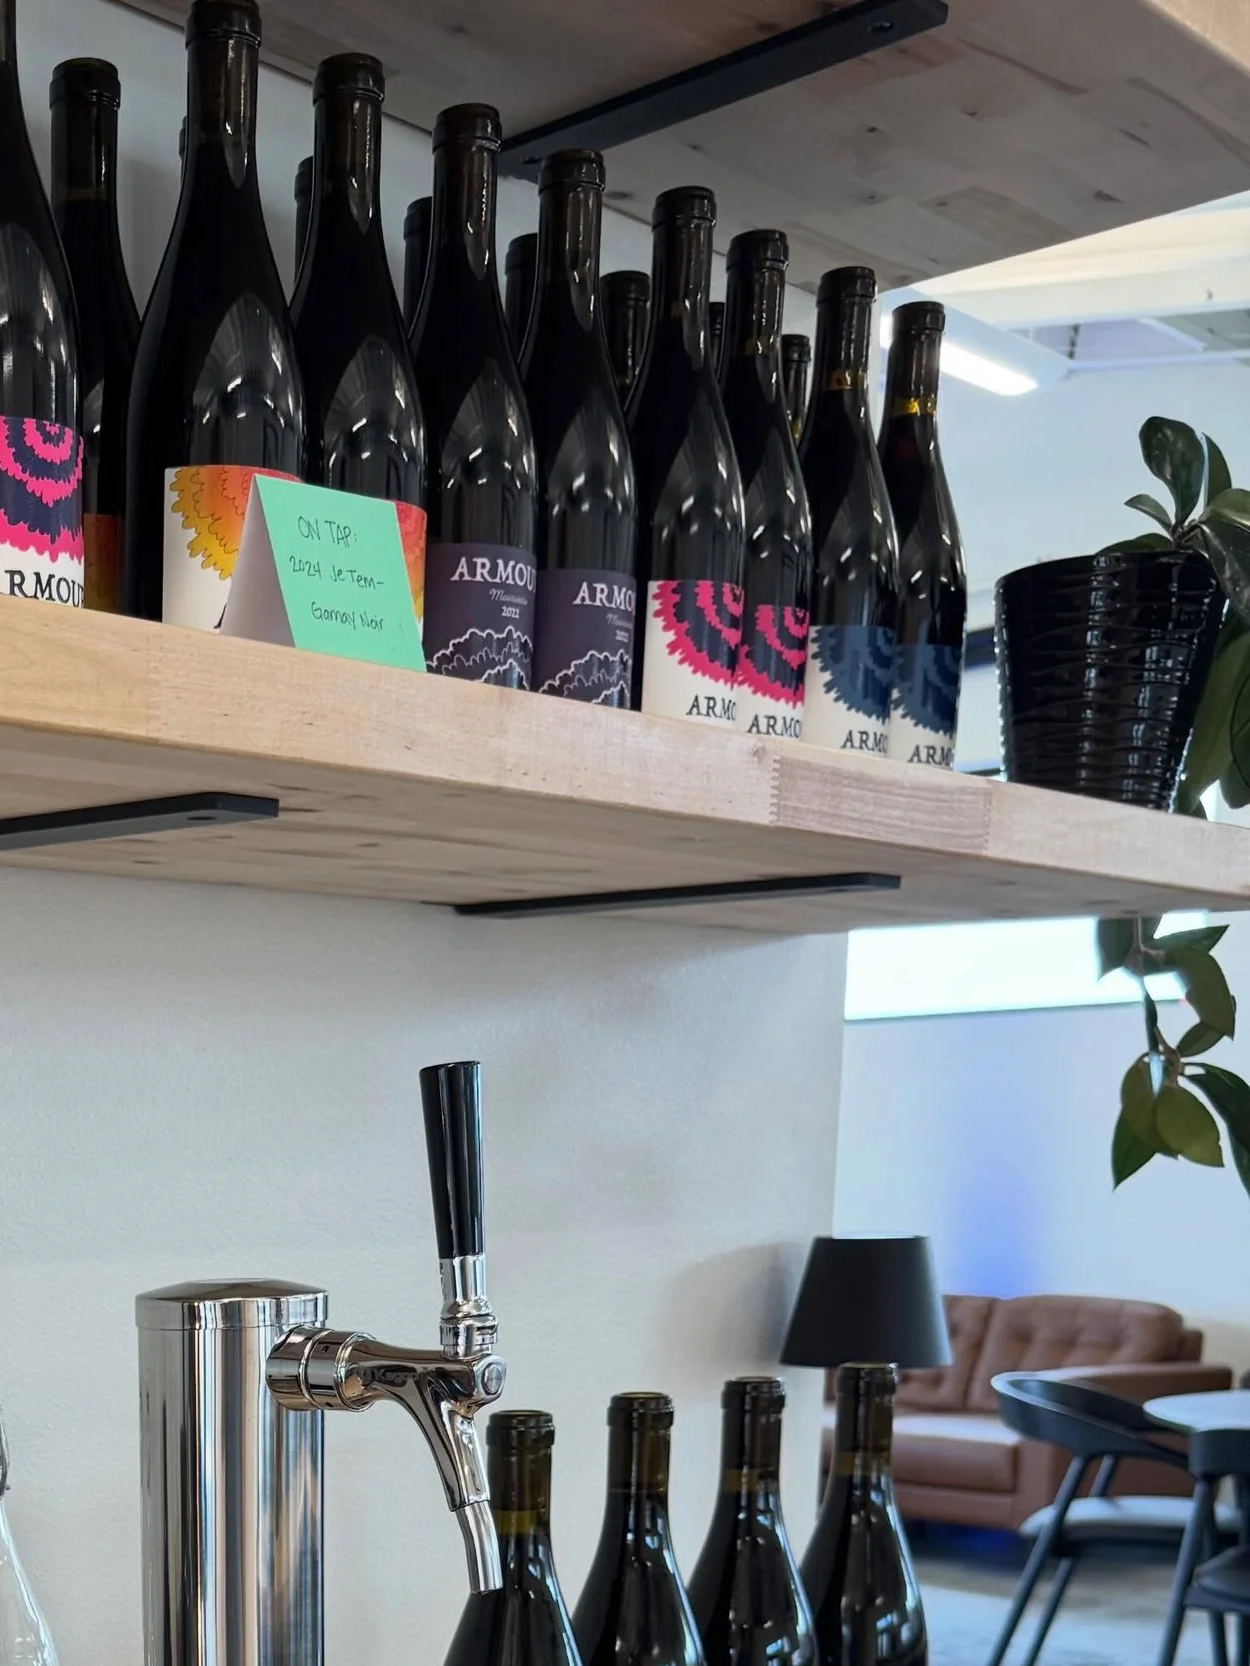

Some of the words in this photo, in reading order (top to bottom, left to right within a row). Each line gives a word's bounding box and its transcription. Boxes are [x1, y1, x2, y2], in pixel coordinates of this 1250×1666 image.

[298, 515, 321, 541] ON
[289, 555, 322, 580] 2024
[572, 581, 636, 616] ARMO
[360, 611, 384, 631] Noir
